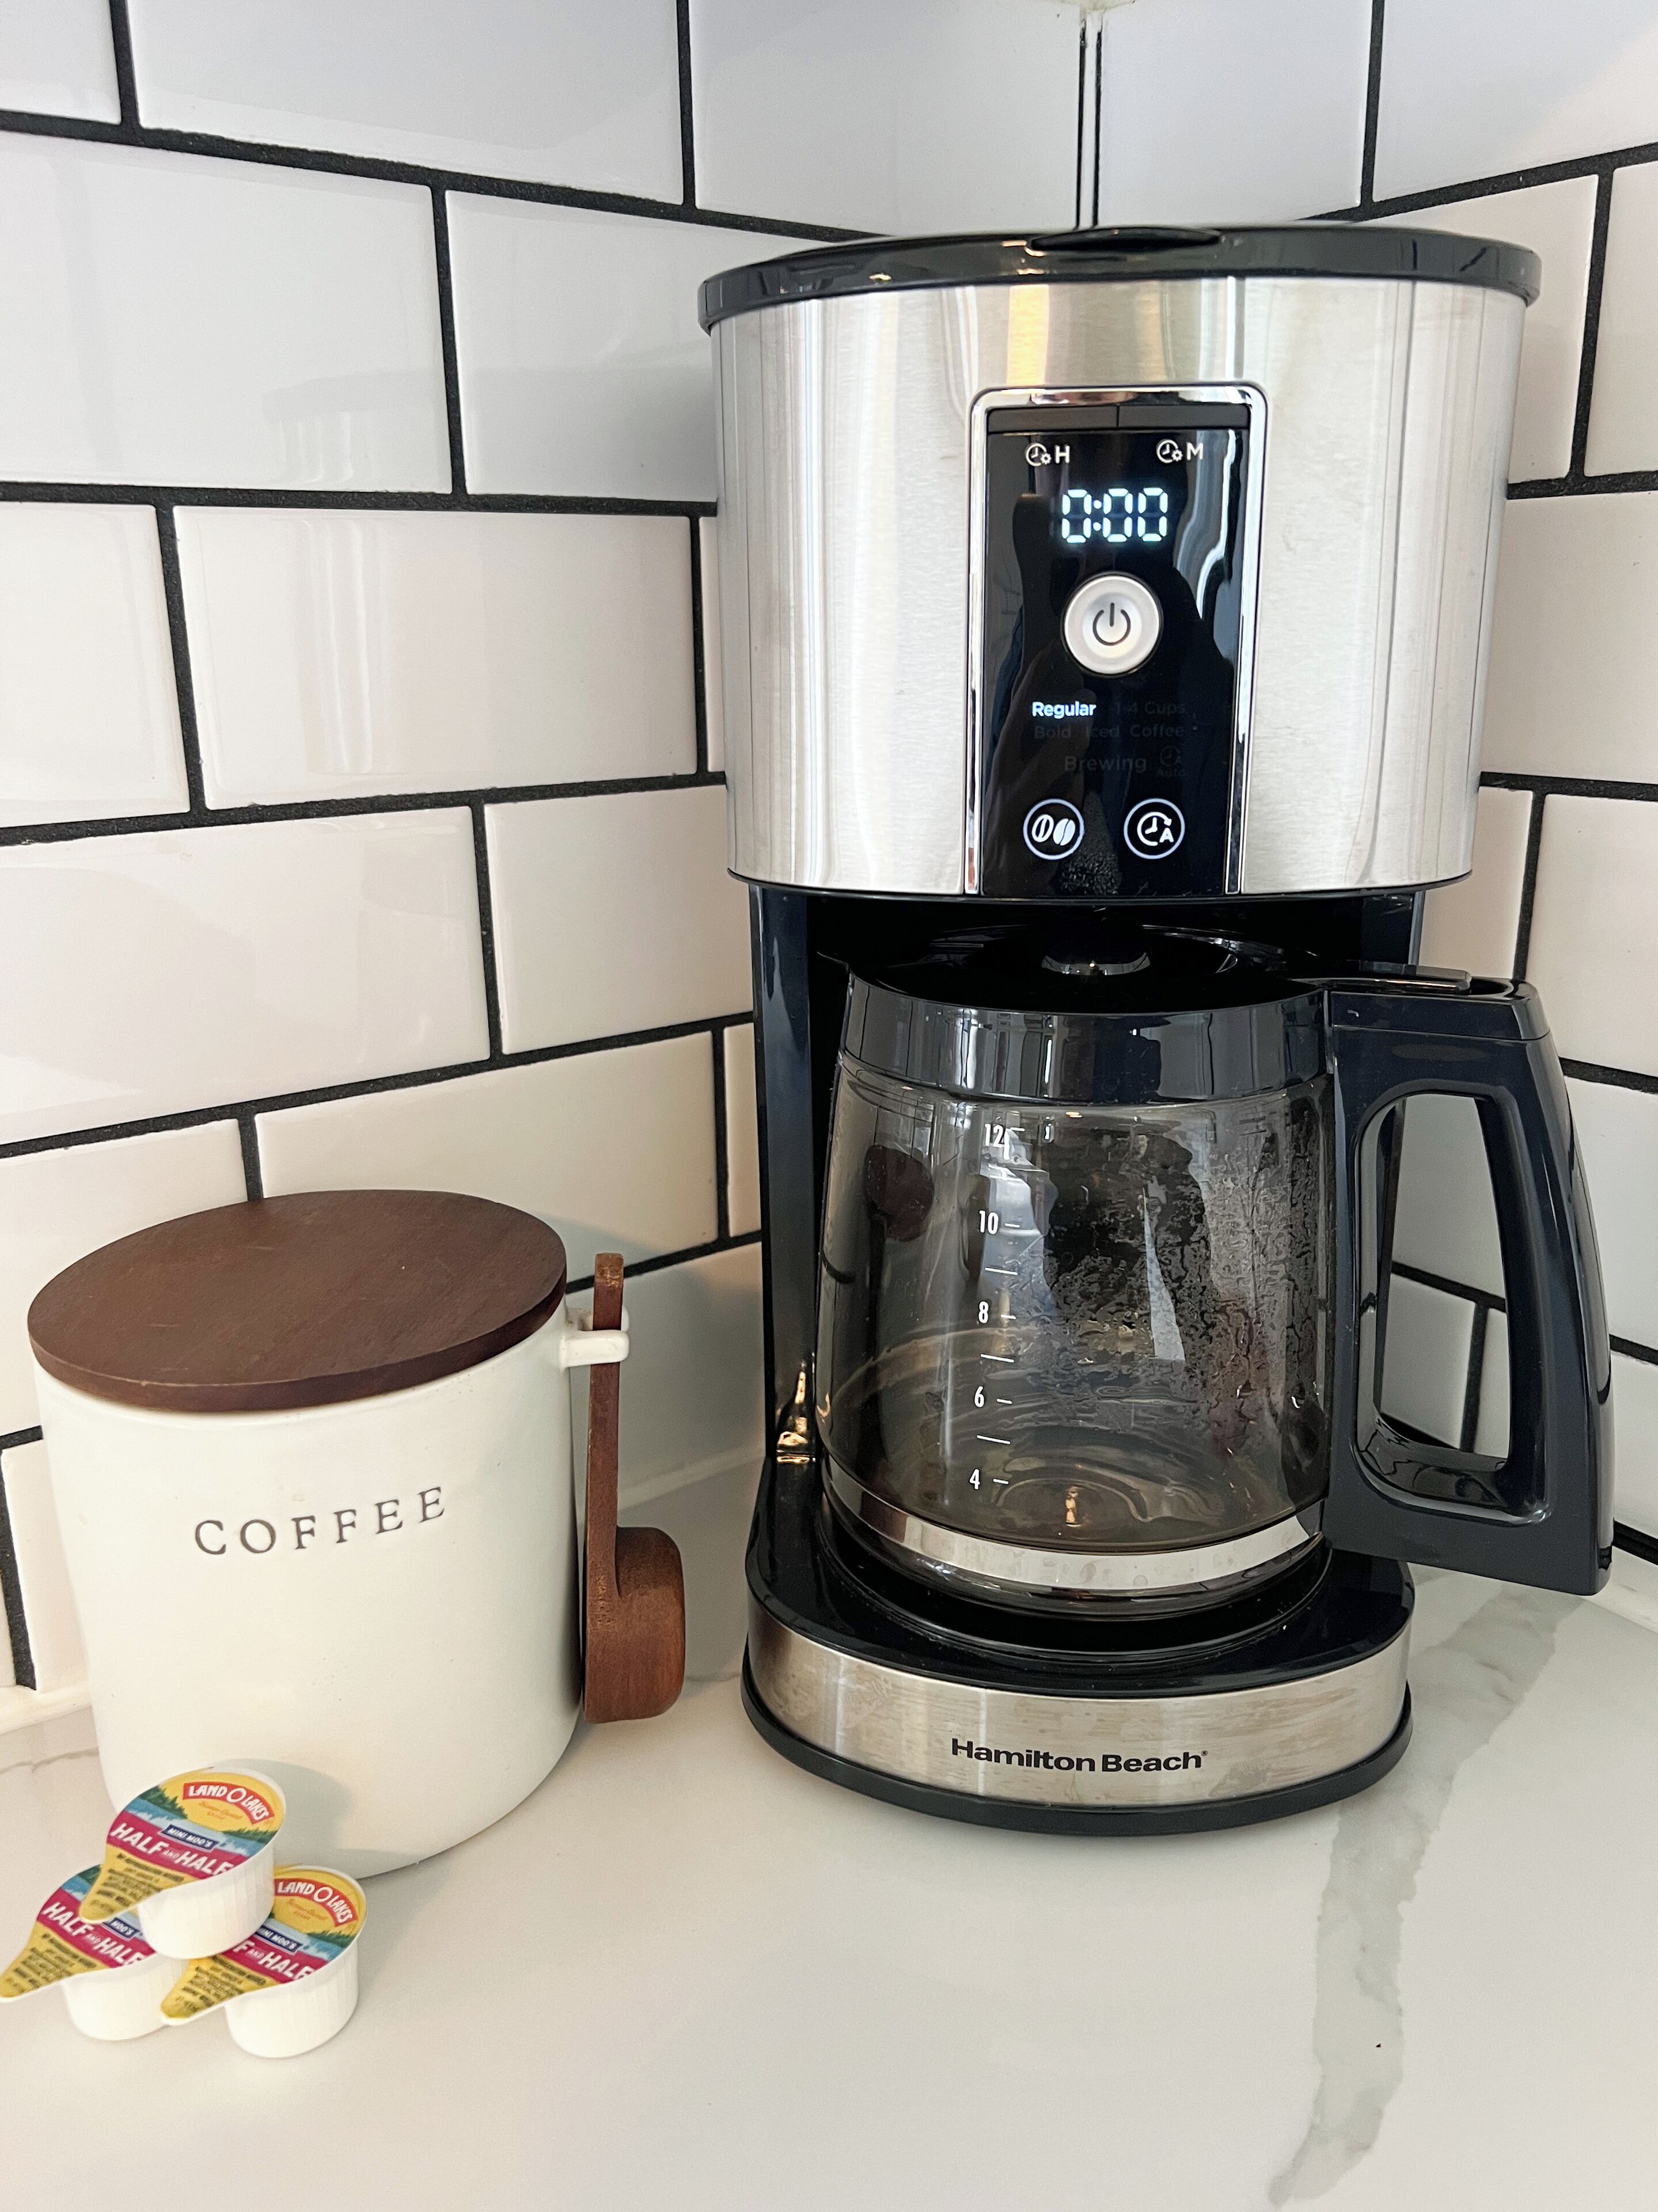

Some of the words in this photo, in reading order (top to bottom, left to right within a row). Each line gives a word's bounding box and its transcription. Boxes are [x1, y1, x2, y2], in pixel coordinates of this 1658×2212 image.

[1055, 445, 1071, 464] H
[1186, 442, 1204, 461] M
[1062, 487, 1168, 543] 0:00
[1031, 700, 1097, 719] Regular
[1144, 701, 1186, 717] Cups
[1034, 725, 1071, 739] Bold
[1086, 724, 1120, 738] Iced
[1129, 724, 1185, 738] Coffee
[1064, 755, 1147, 773] Brewing
[984, 1123, 1004, 1148] 12
[978, 1210, 999, 1235] 10
[978, 1301, 989, 1324] 8
[974, 1385, 985, 1408] 6
[969, 1469, 980, 1490] 4
[195, 1486, 445, 1555] COFFEE
[951, 1737, 1095, 1772] Hamilton
[1102, 1751, 1201, 1772] Beach
[188, 1785, 228, 1797] LAND
[241, 1795, 270, 1821] LAKES
[166, 1827, 187, 1839] MINI
[110, 1823, 170, 1855] HALF
[174, 1851, 234, 1876] HALF
[278, 1881, 316, 1895] LAND
[327, 1895, 353, 1923] LAKES
[43, 1902, 95, 1936] HALF
[258, 1951, 315, 1980] HALF
